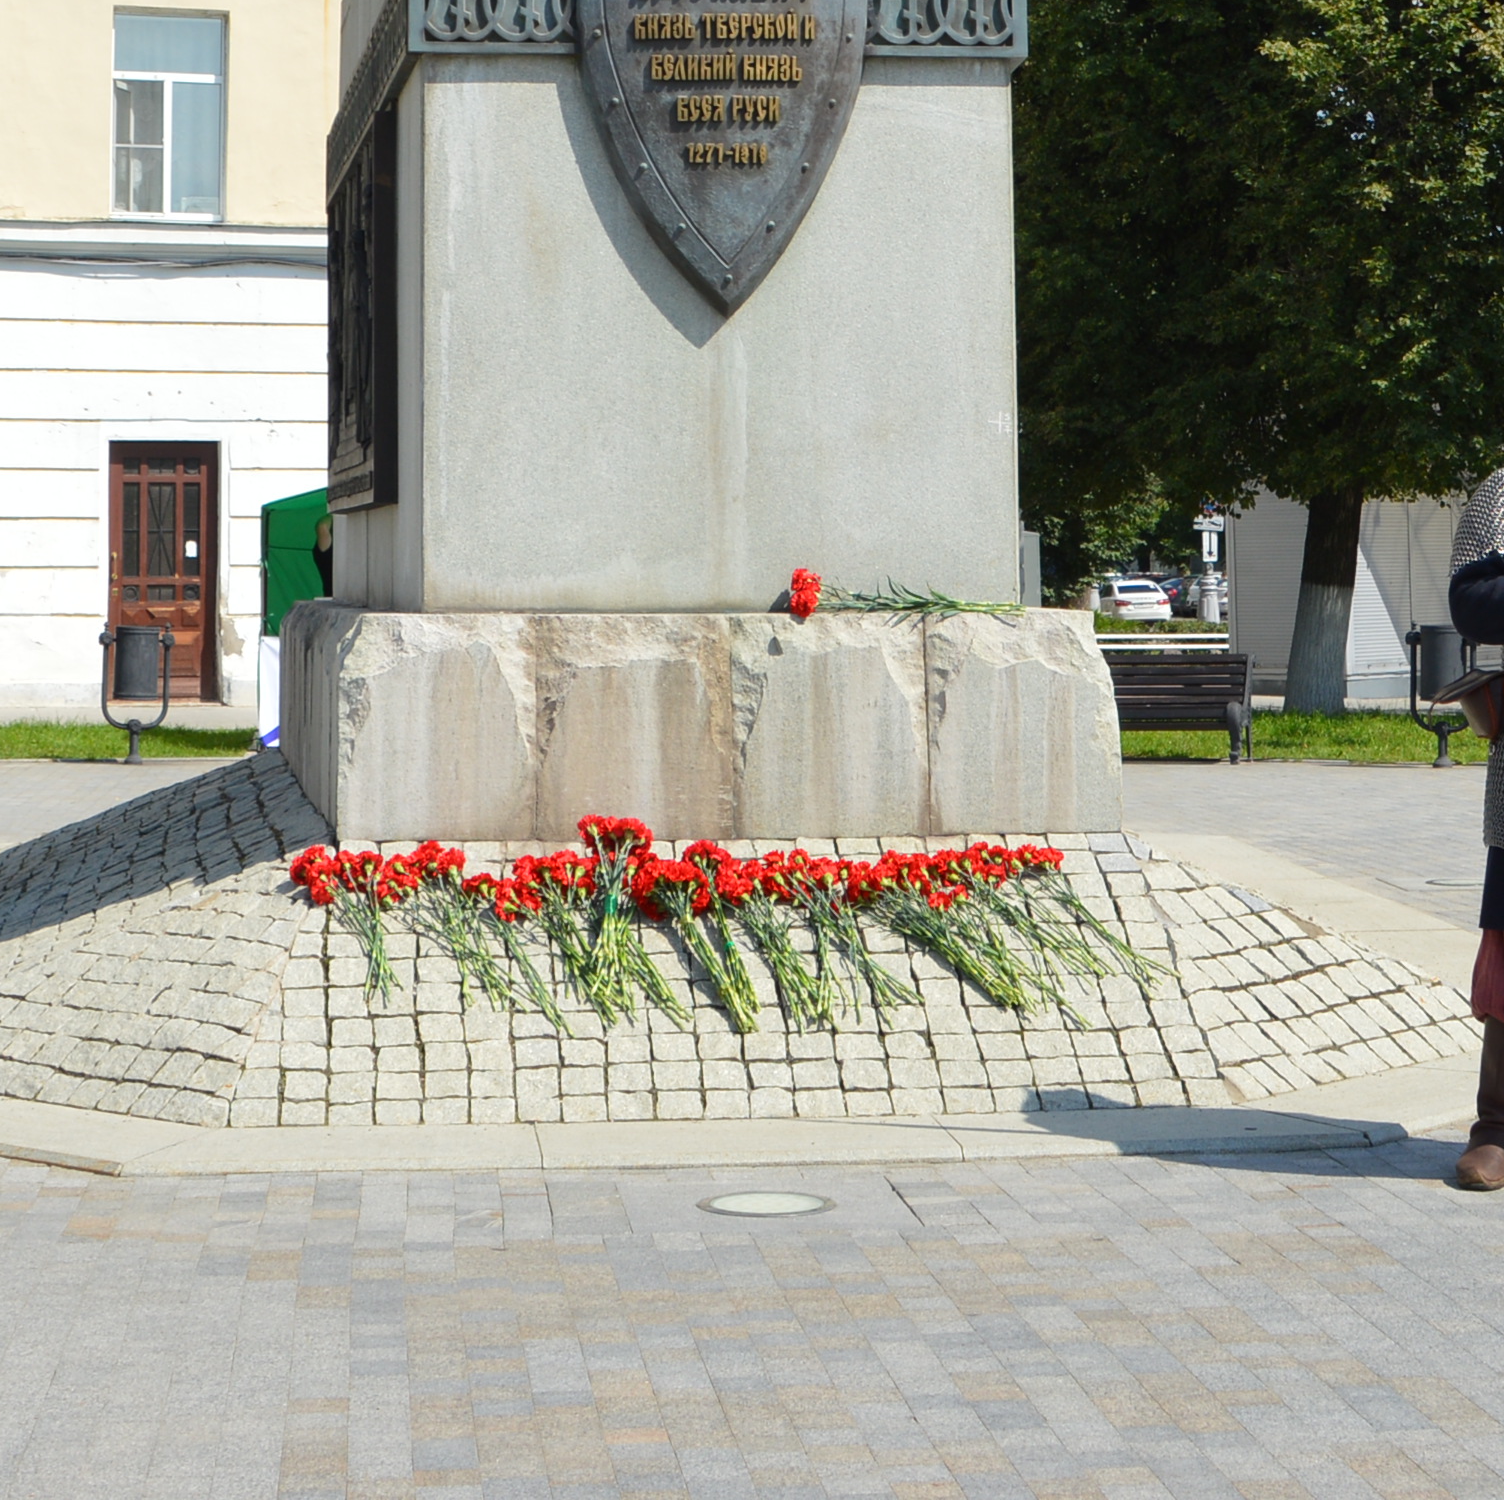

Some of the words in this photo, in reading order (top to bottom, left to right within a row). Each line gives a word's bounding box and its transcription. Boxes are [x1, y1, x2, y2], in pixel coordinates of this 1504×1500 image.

[634, 13, 696, 40] КНЯЗЬ
[702, 8, 798, 40] ТВЕРСКОЙ
[804, 14, 816, 40] И
[651, 48, 736, 81] ВЕЛИКИЙ
[743, 54, 803, 81] КНЯЗЬ
[677, 95, 725, 122] ВСЕЯ
[732, 95, 781, 122] РУСИ
